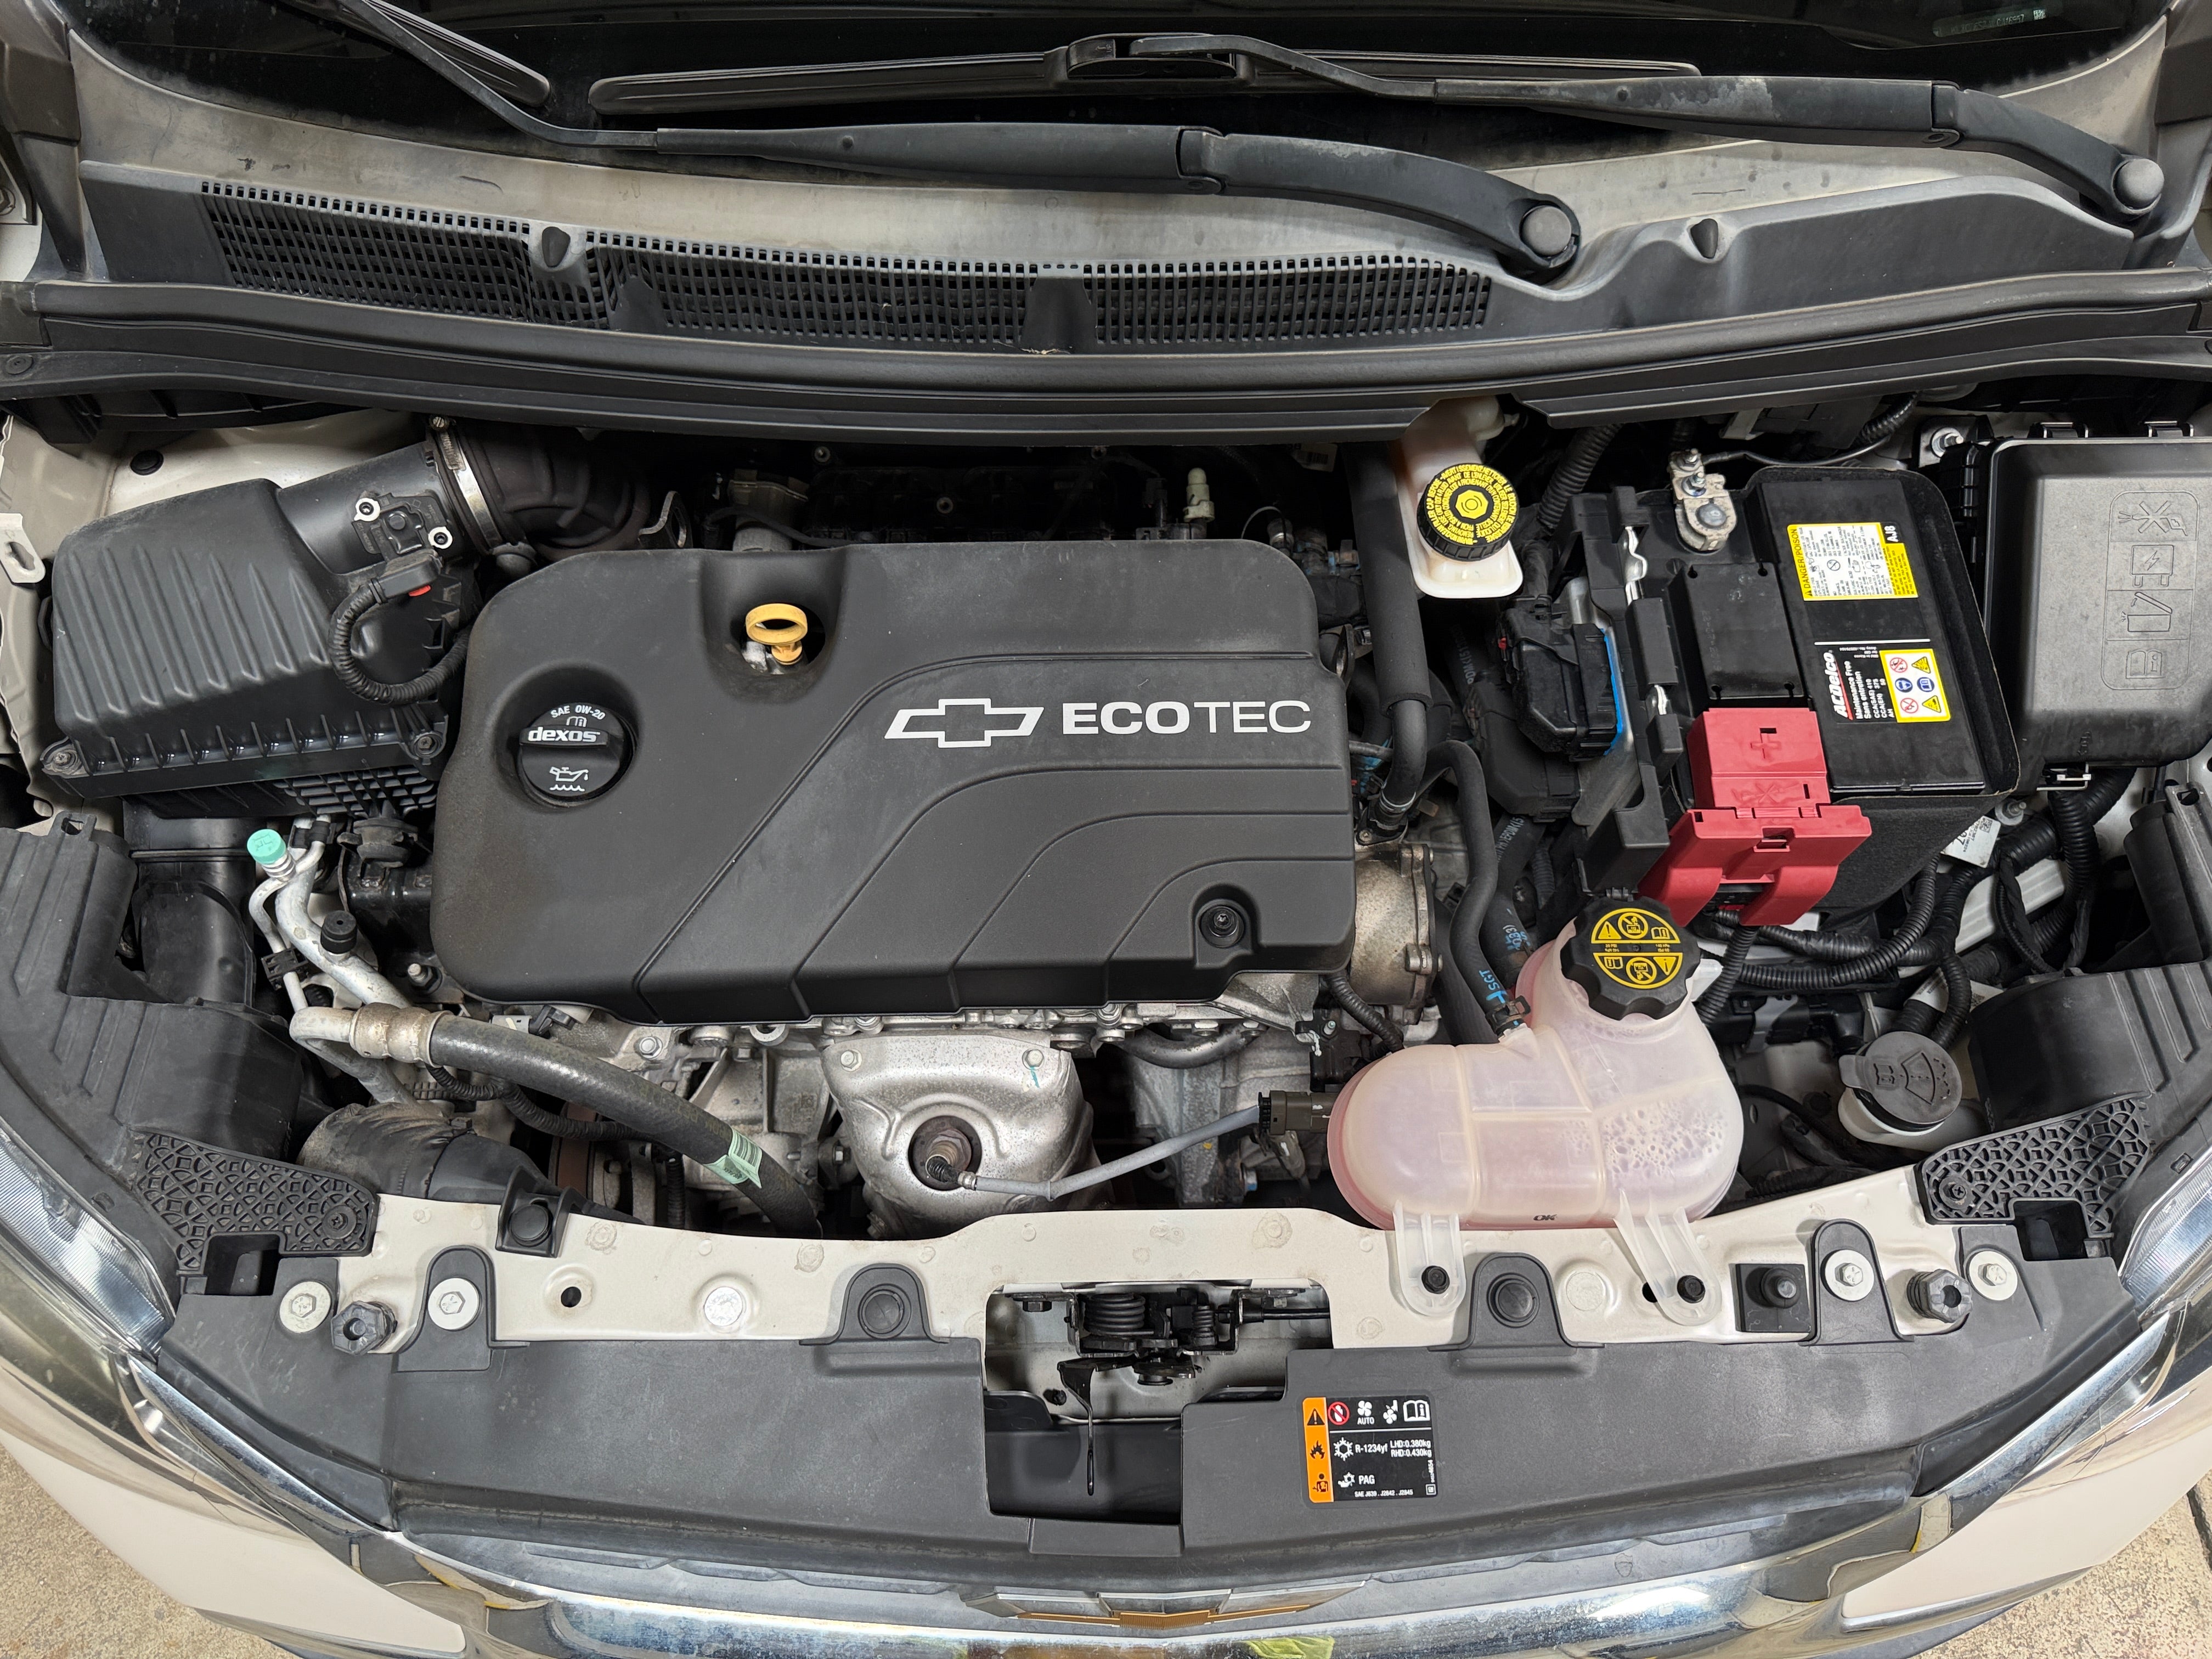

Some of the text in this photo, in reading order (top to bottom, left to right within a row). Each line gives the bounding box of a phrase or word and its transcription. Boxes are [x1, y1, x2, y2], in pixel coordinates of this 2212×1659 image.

[1883, 525, 1899, 543] AJ8
[1790, 528, 1809, 590] DANGER/POISON
[1823, 652, 1848, 718] ACDelco
[1844, 661, 1863, 719] Maintenance Free
[550, 704, 606, 720] SAE 0W-20
[1861, 702, 1871, 719] Sans
[1868, 690, 1880, 719] CCA(SAE)
[1063, 701, 1311, 735] ECOTEC
[527, 727, 600, 742] dexos
[1357, 1417, 1375, 1425] AUTO
[1355, 1443, 1388, 1454] R-1234yf
[1358, 1474, 1375, 1485] PAG
